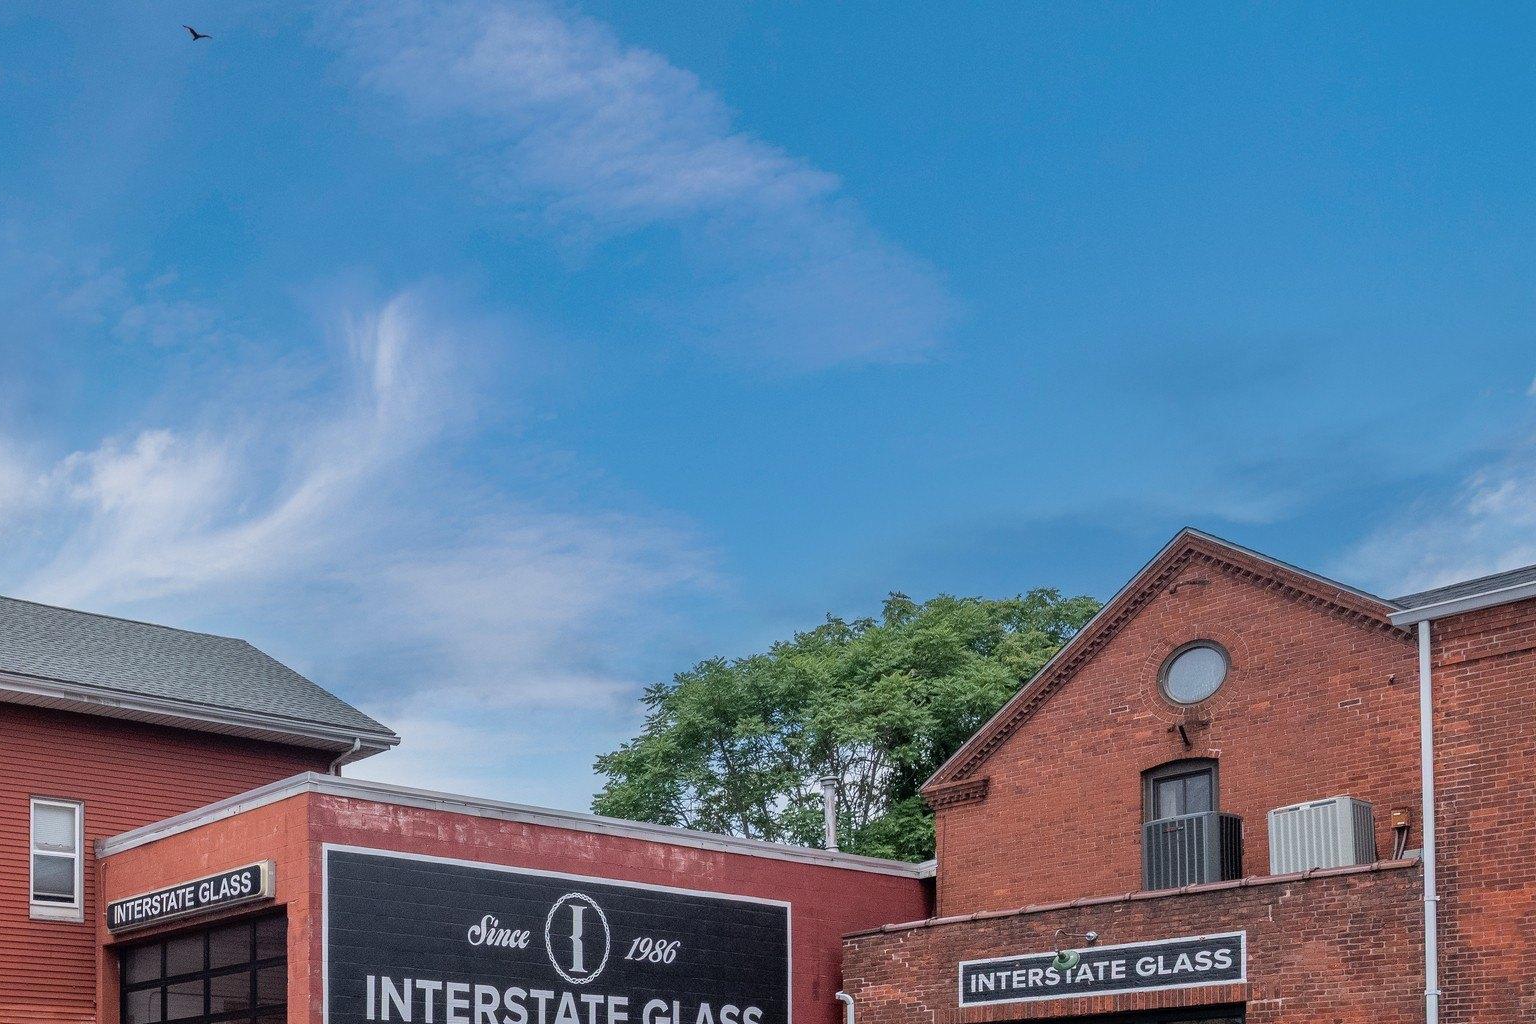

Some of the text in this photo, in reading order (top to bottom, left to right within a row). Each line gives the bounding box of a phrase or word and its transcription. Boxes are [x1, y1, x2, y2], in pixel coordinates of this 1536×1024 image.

[114, 871, 252, 924] INTERSTATE GLASS
[467, 914, 530, 949] Since
[624, 937, 681, 964] 1986
[970, 949, 1233, 993] INTERSTATE GLASS
